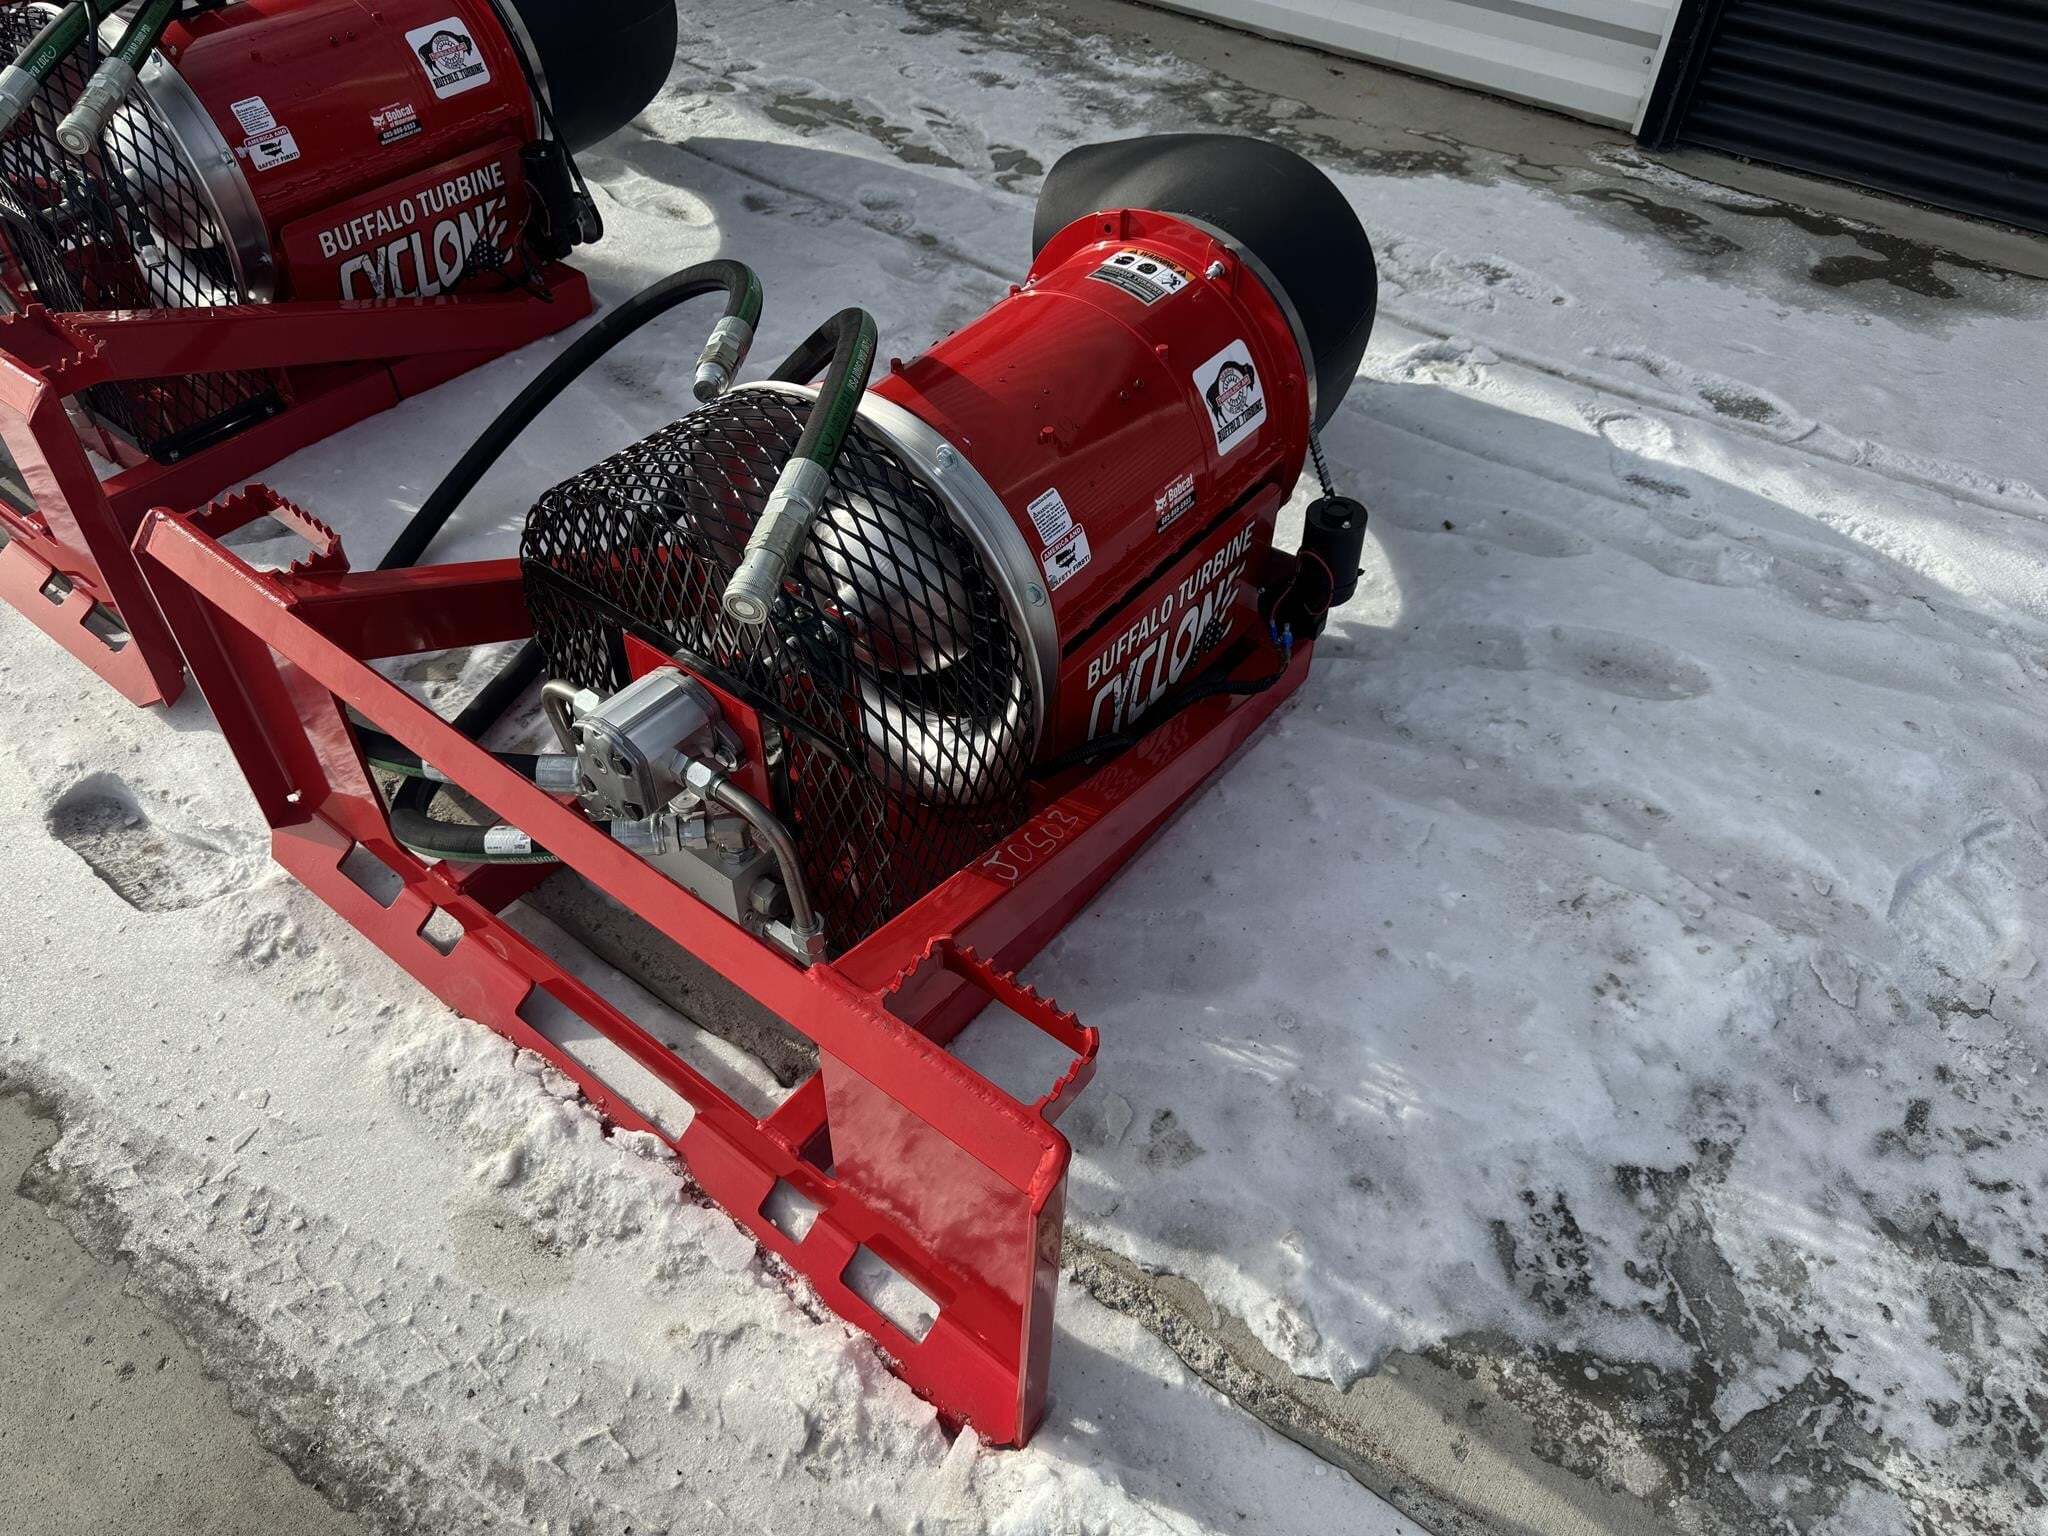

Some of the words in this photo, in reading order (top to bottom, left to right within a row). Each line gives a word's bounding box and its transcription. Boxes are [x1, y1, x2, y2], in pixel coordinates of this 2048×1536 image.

[37, 53, 49, 69] 207
[385, 103, 415, 122] Bobcat
[247, 133, 274, 146] AMERICA
[274, 128, 288, 138] AND
[258, 158, 280, 170] SAFETY
[280, 151, 299, 163] FIRST!
[318, 198, 416, 259] BUFFALO
[416, 161, 505, 217] TURBINE
[340, 196, 513, 299] CYCLONE
[1168, 472, 1193, 503] Bobcat
[1043, 536, 1069, 561] AMERICA
[1069, 526, 1081, 540] AND
[1072, 554, 1090, 573] FIRST!
[1087, 594, 1174, 691] BUFFALO
[1177, 520, 1256, 609] TURBINE
